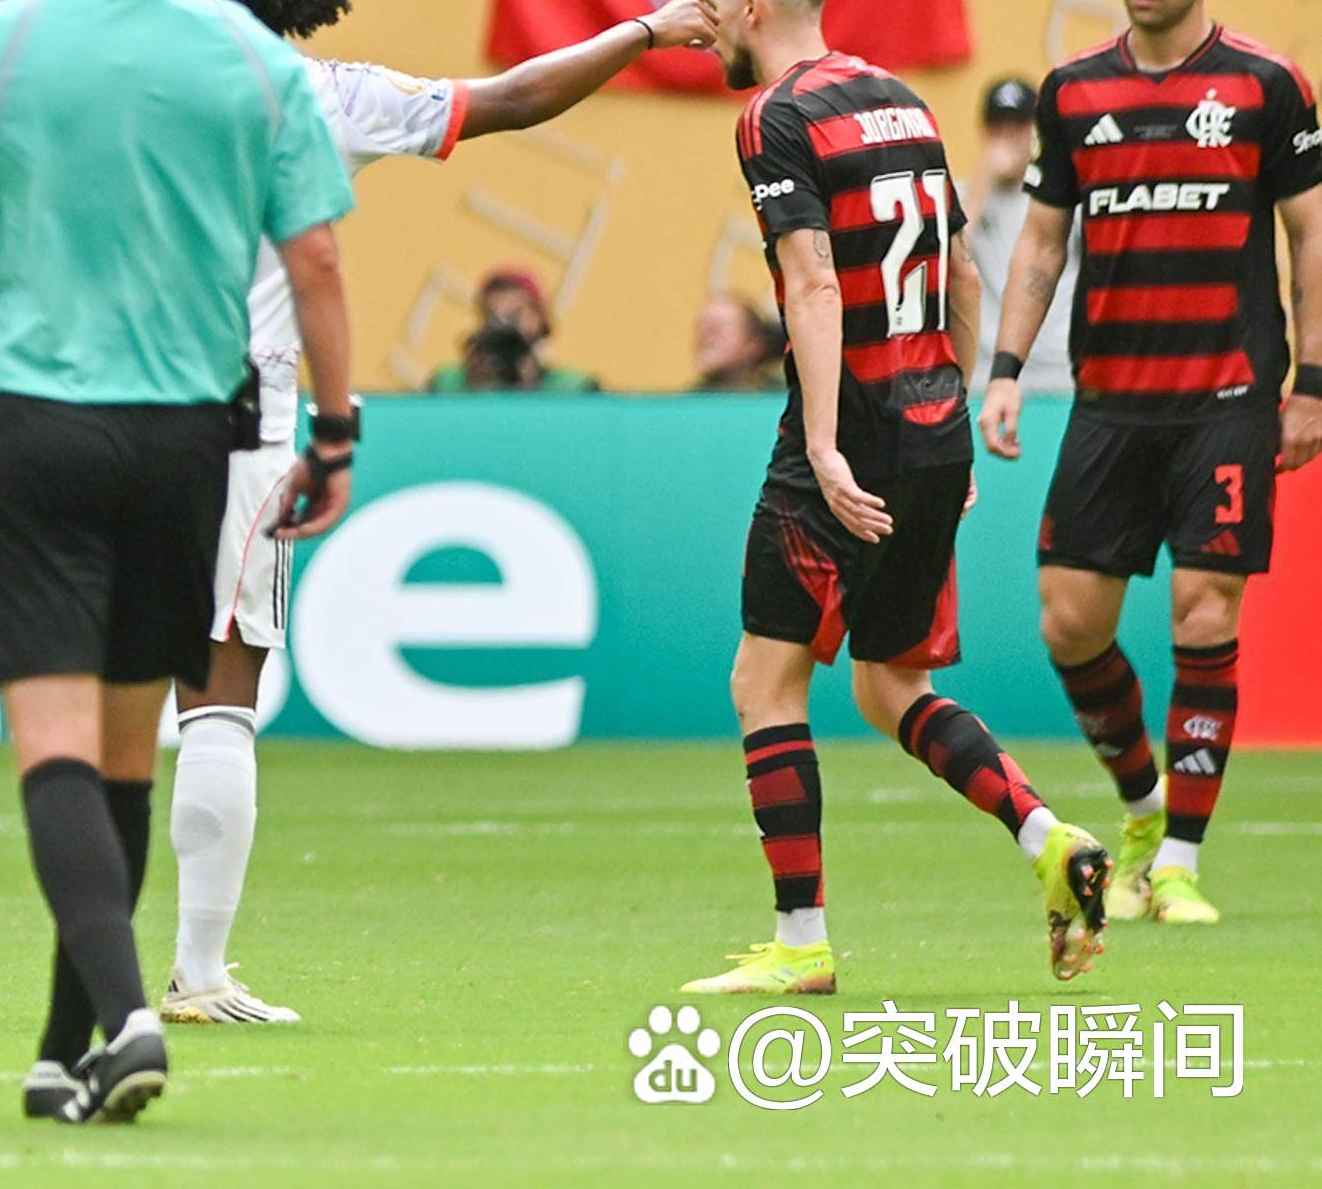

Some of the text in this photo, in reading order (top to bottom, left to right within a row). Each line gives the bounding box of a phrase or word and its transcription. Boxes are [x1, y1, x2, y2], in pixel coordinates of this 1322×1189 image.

[1089, 183, 1229, 216] FLABET
[870, 170, 947, 339] 21
[1215, 463, 1243, 524] 3
